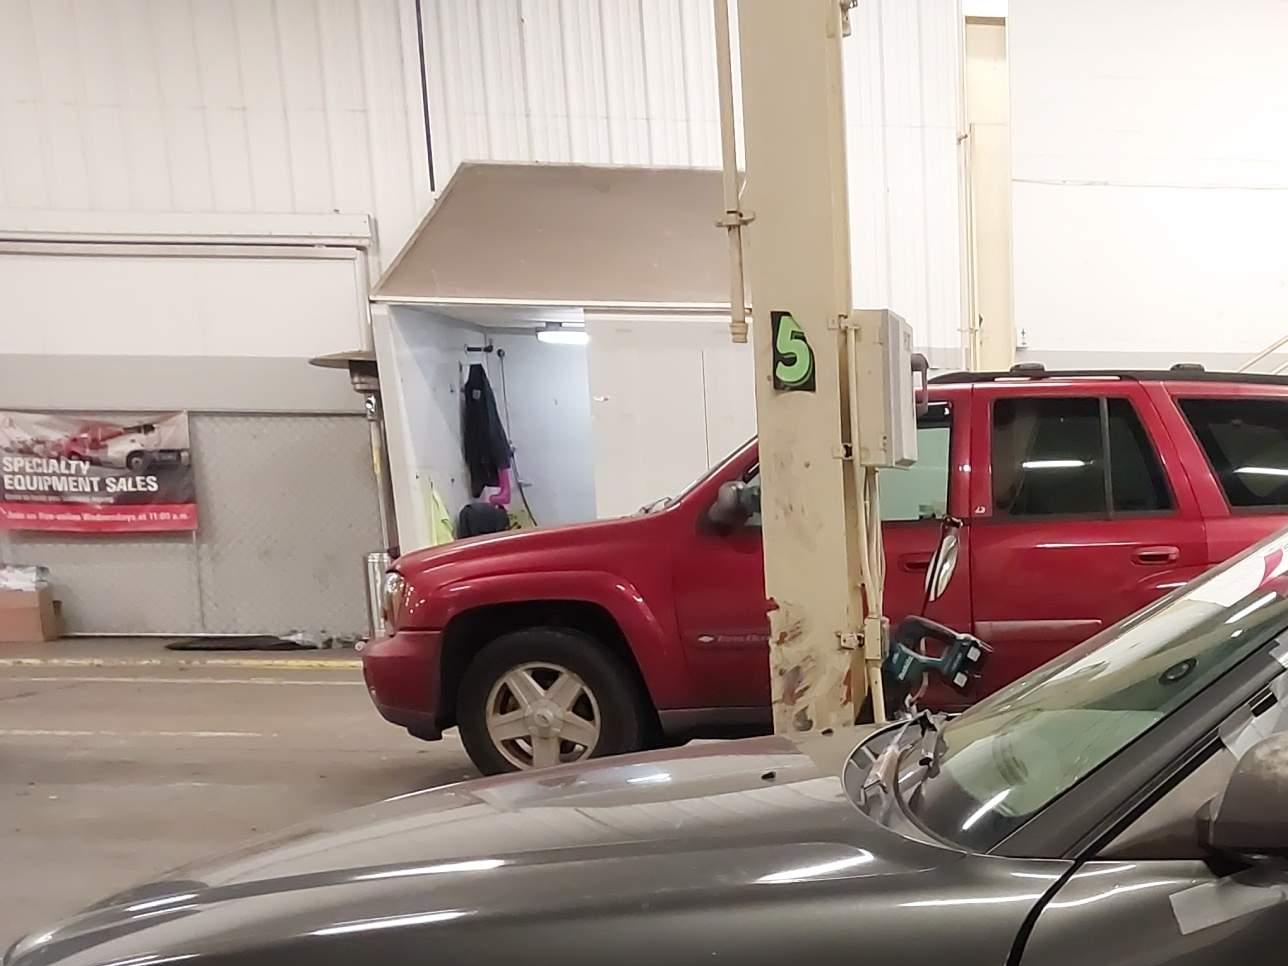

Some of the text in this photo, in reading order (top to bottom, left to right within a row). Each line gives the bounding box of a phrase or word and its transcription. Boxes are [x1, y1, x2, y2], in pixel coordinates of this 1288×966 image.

[776, 316, 811, 383] 5
[2, 457, 91, 475] SPECIALTY
[3, 474, 159, 492] EQUIPMENT SALES
